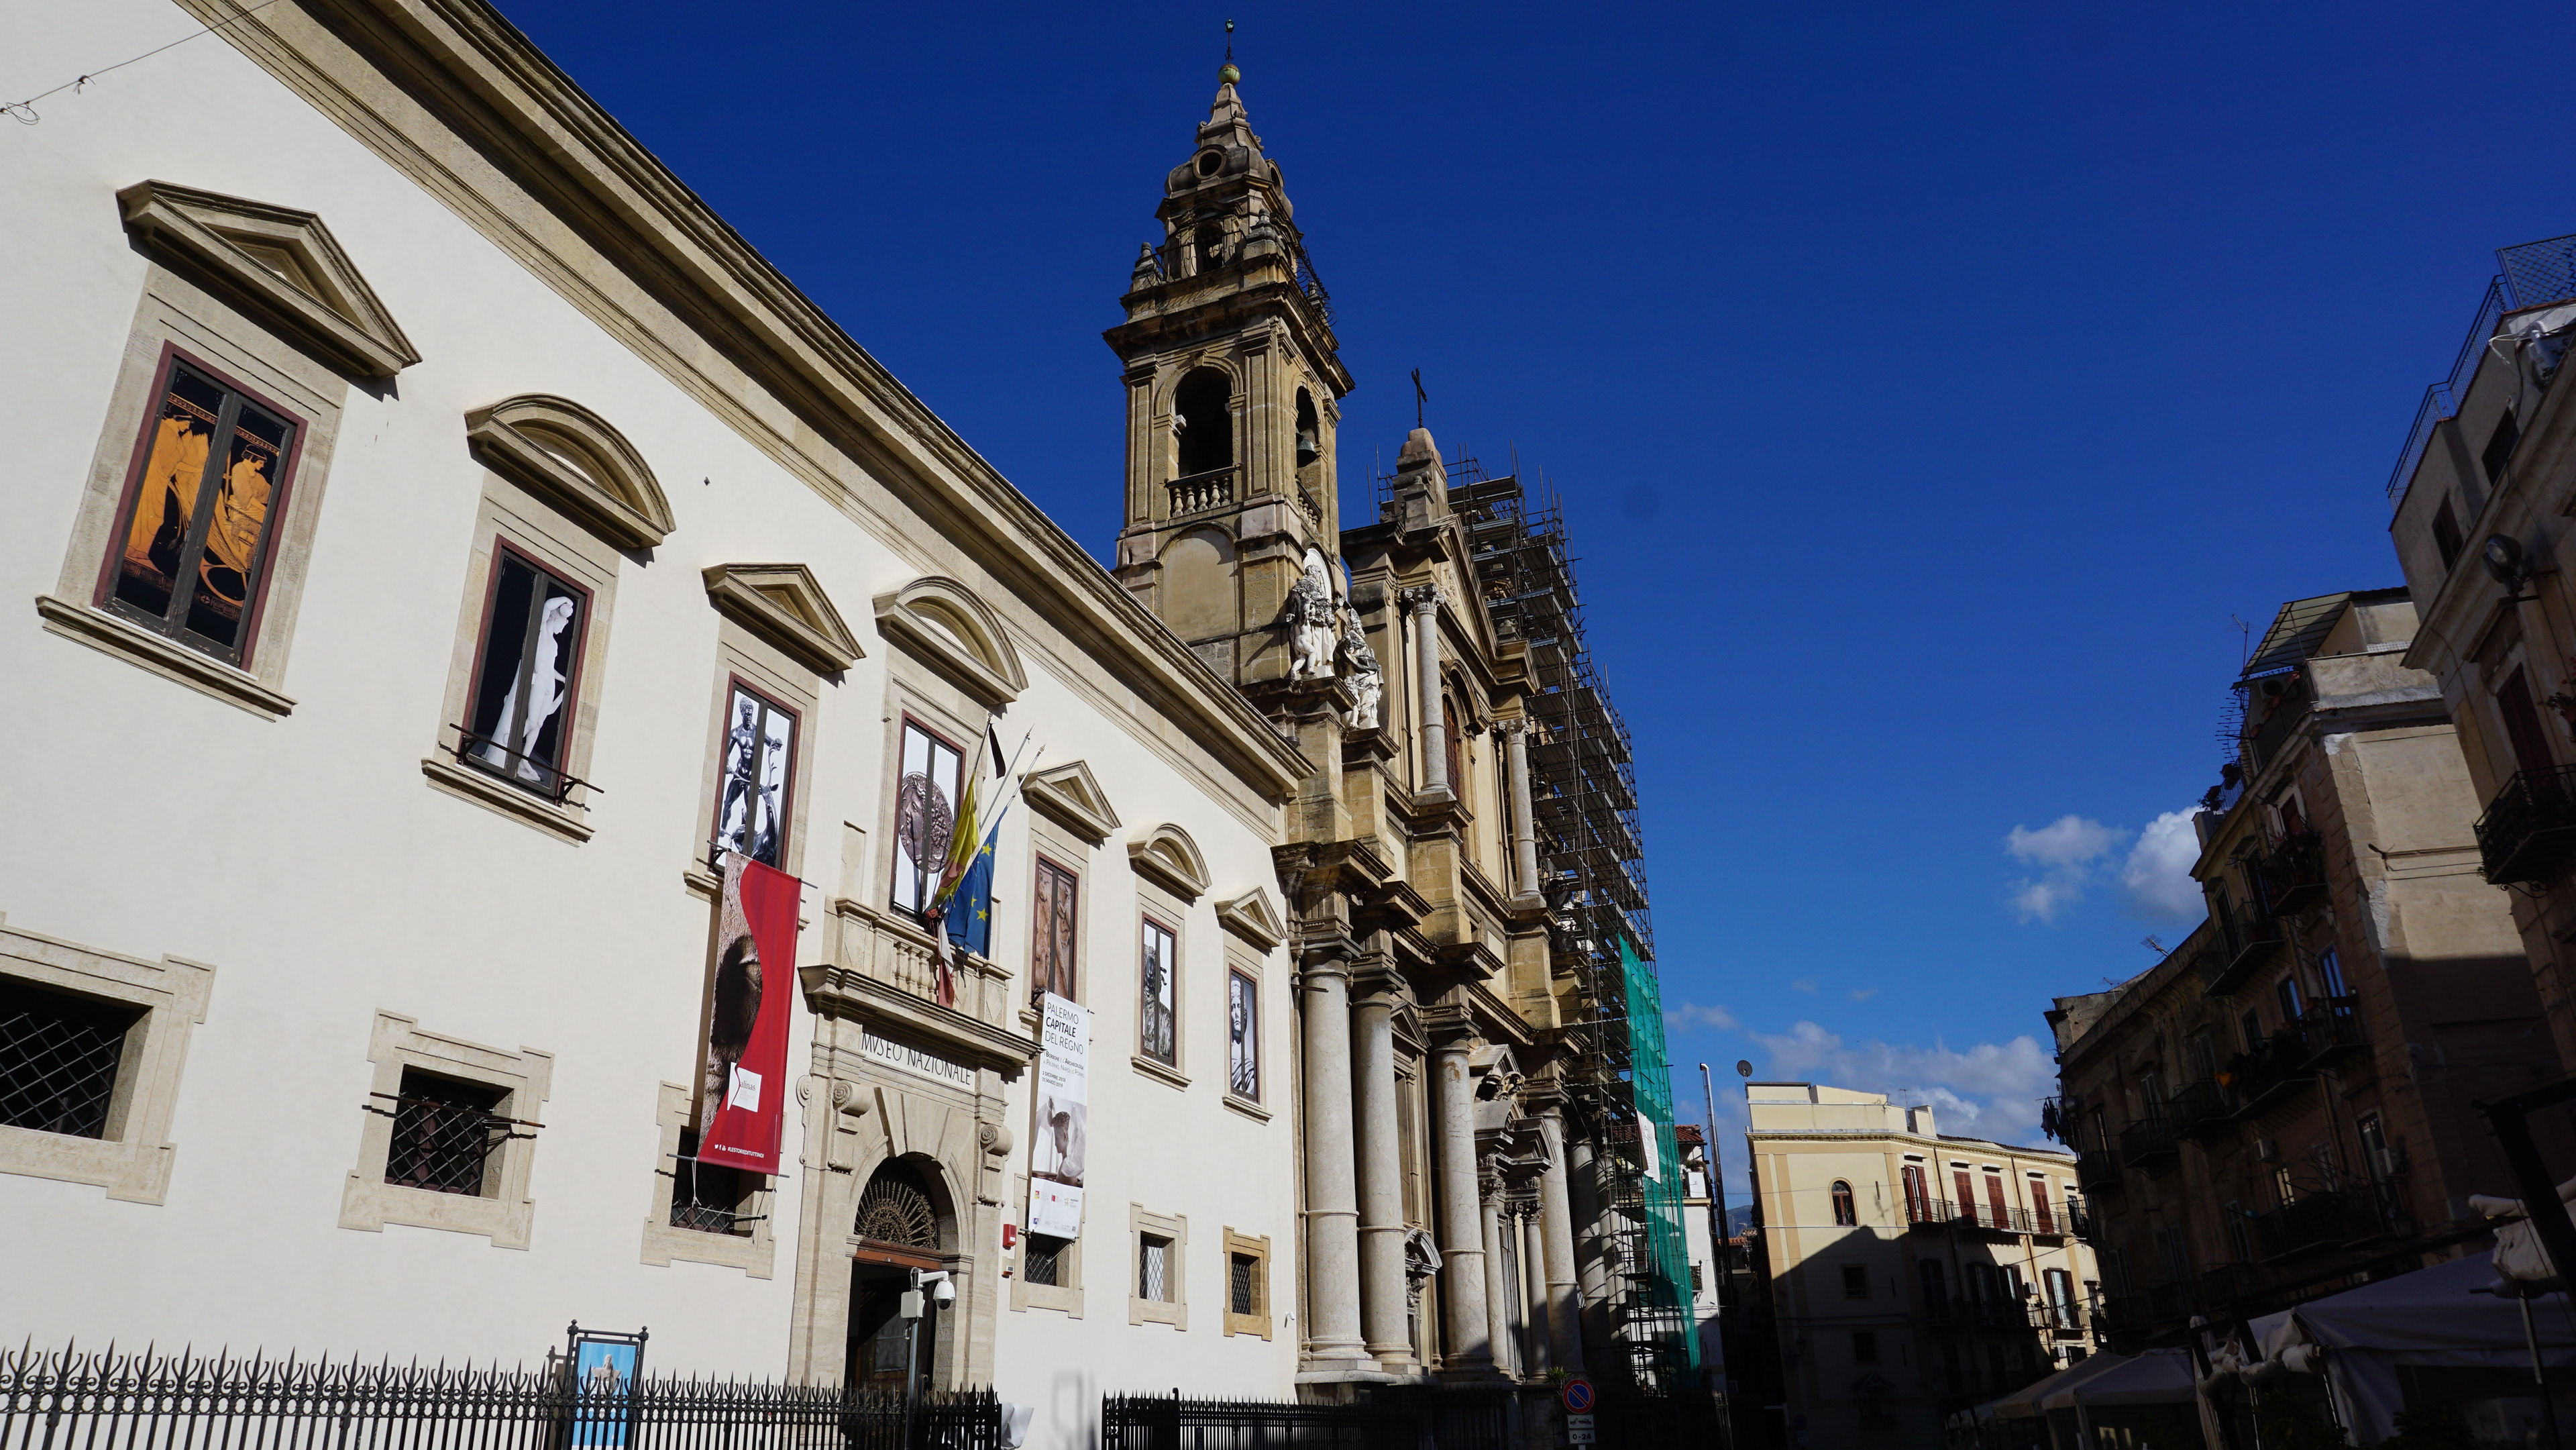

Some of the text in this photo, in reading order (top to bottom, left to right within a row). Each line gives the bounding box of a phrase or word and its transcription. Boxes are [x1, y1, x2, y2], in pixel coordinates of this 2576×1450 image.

[1047, 1002, 1079, 1025] PALERMO
[1046, 1017, 1077, 1037] CAPITALE
[1044, 1031, 1083, 1055] DEL REGNO
[908, 1047, 971, 1086] NAZIONALE
